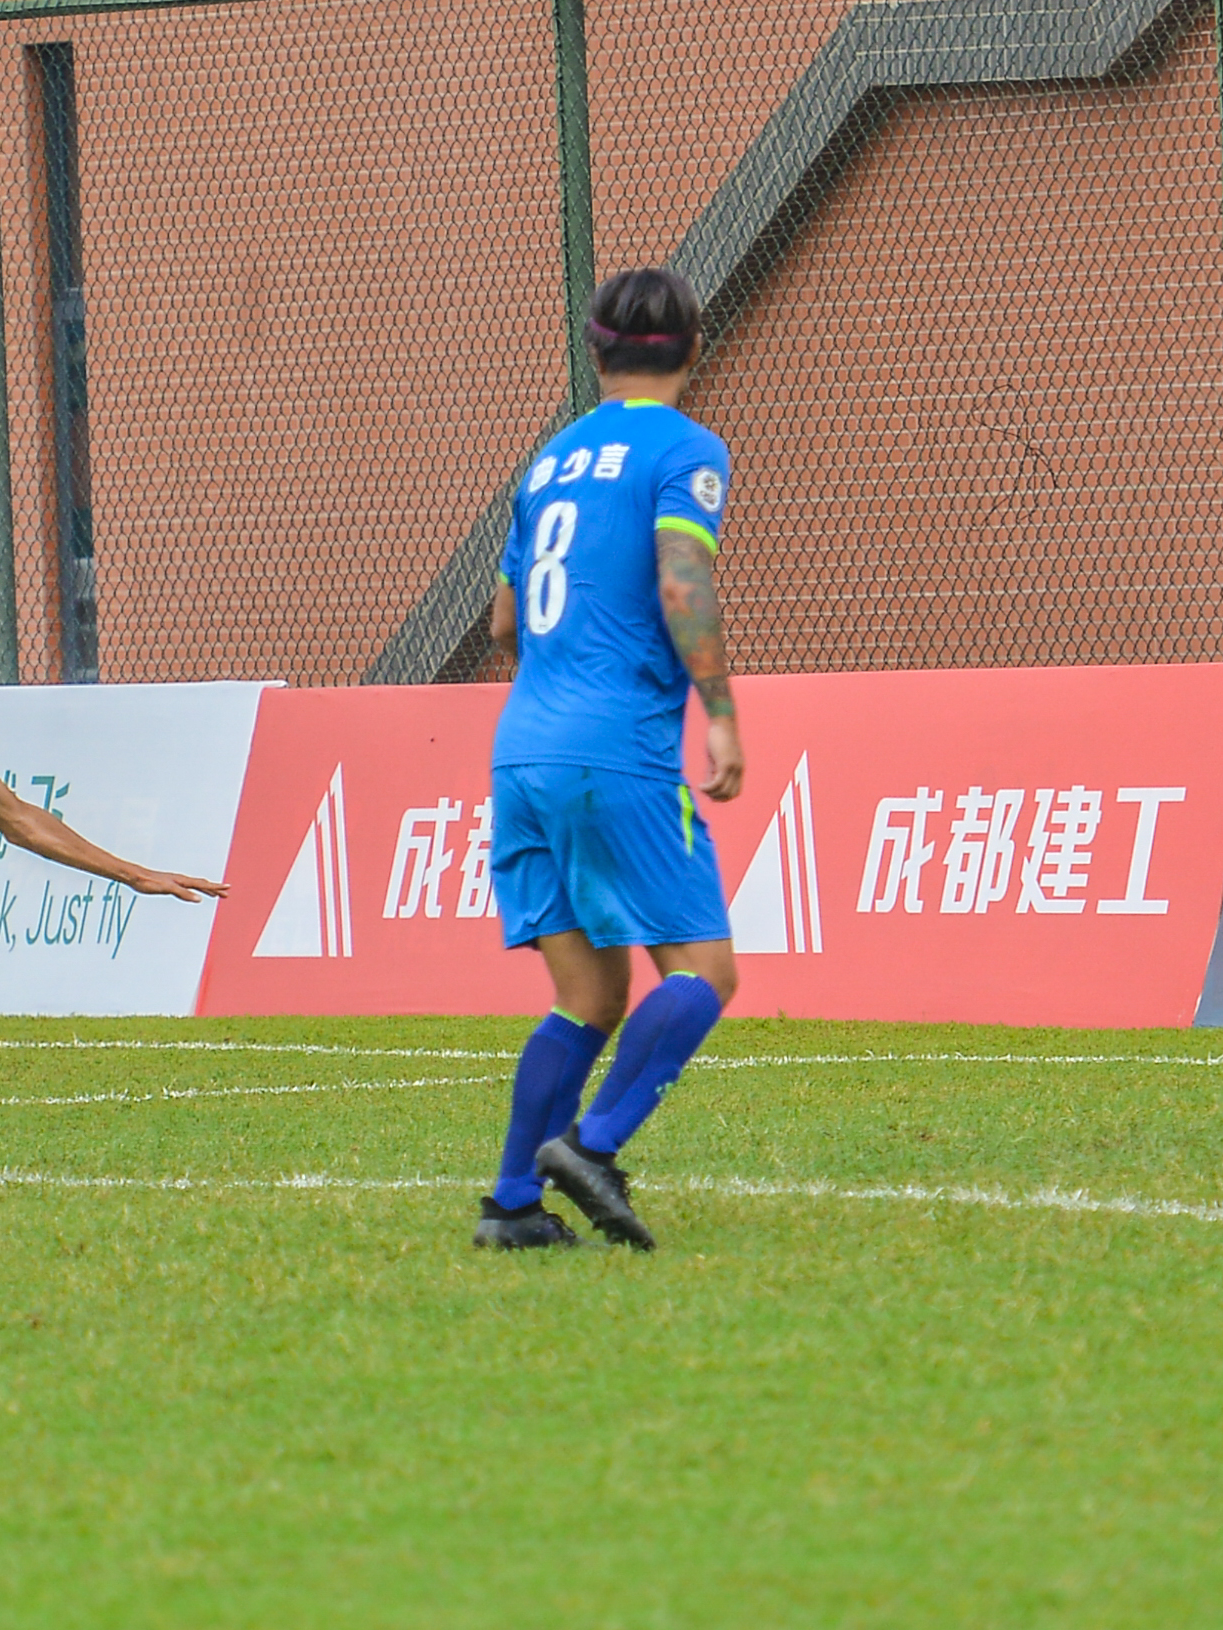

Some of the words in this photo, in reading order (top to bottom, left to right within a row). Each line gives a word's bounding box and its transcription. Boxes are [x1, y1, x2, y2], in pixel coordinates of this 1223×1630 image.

[528, 501, 578, 634] 8
[856, 784, 1186, 915] 成都建工
[25, 879, 94, 945] Just
[96, 880, 138, 960] fly
